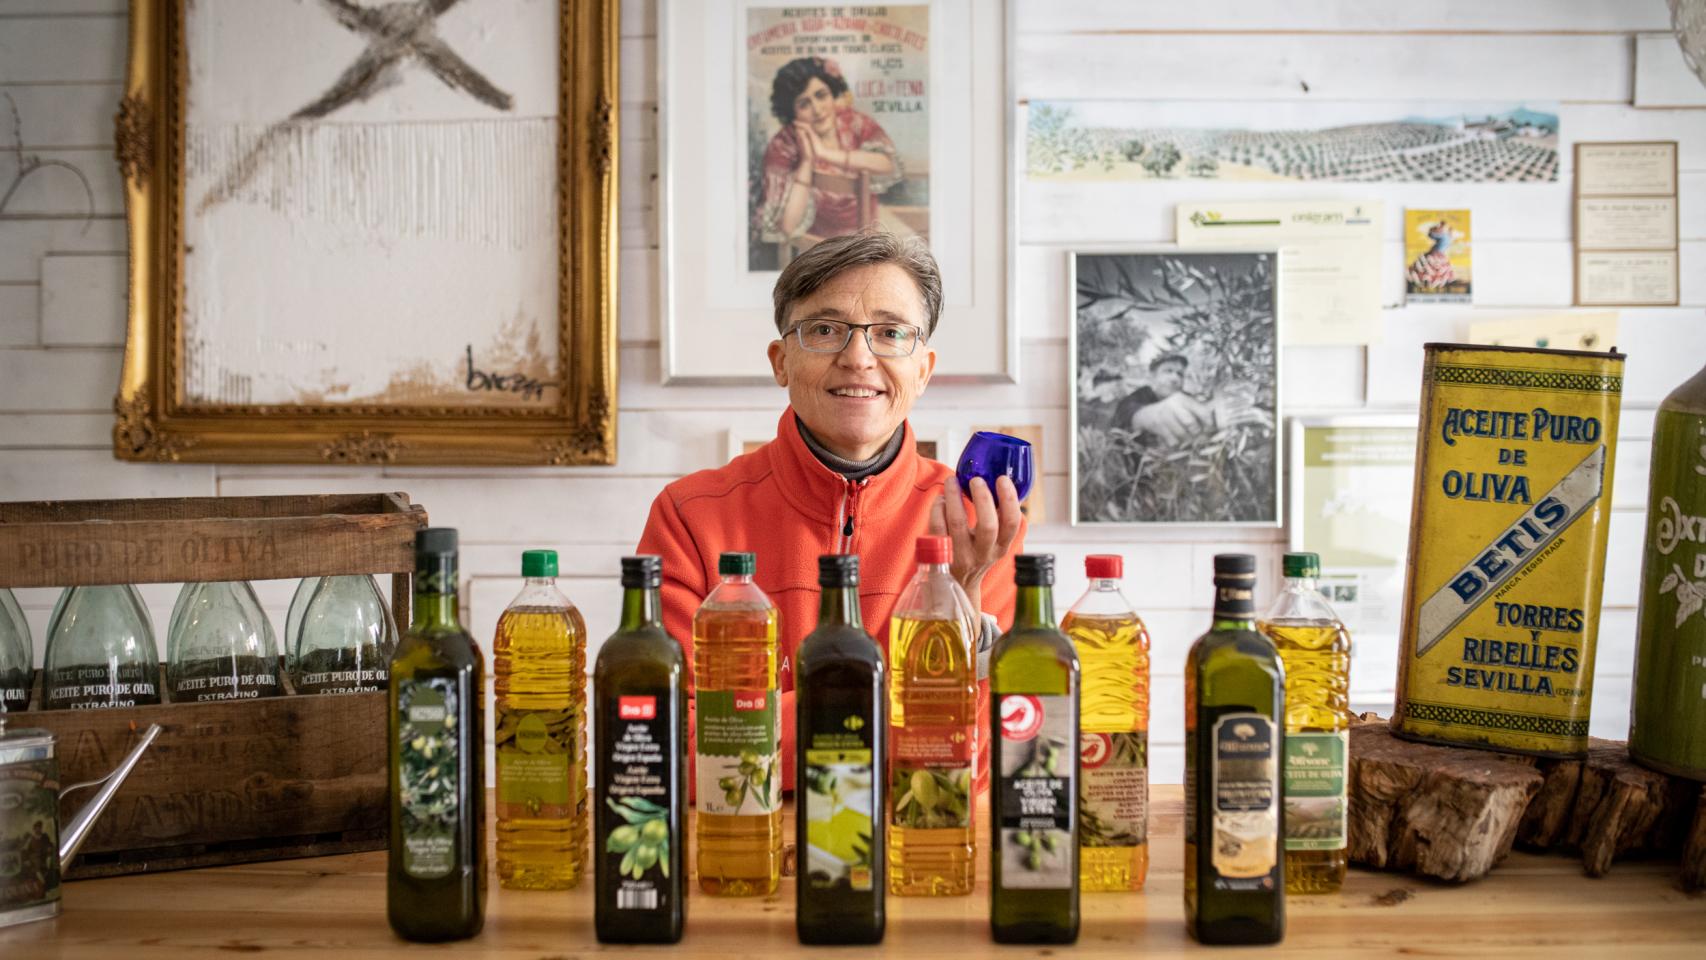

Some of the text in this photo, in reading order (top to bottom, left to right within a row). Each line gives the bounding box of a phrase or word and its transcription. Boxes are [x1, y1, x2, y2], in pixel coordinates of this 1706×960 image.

[872, 101, 923, 113] SEVILLA
[1441, 406, 1601, 446] ACEITE PURO
[1498, 448, 1527, 466] DE
[1442, 469, 1533, 505] OLIVA
[180, 535, 283, 566] OLIVA
[1448, 496, 1570, 604] BETIS
[1495, 538, 1566, 600] MARCA REGISTRADA
[1494, 601, 1584, 633] TORRES
[1530, 629, 1543, 643] Y
[1463, 636, 1579, 673] RIBELLES
[209, 675, 239, 688] PURO
[240, 674, 255, 686] DE
[302, 672, 329, 685] ACEITE
[331, 671, 359, 682] PURO
[361, 670, 375, 681] DE
[1447, 666, 1556, 697] SEVILLA
[50, 686, 80, 701] ACEITE
[83, 684, 114, 697] PURO
[115, 683, 131, 695] DE
[197, 690, 259, 703] EXTRAFINO
[320, 685, 378, 697] EXTRAFINO
[71, 700, 135, 710] EXTRAFINO
